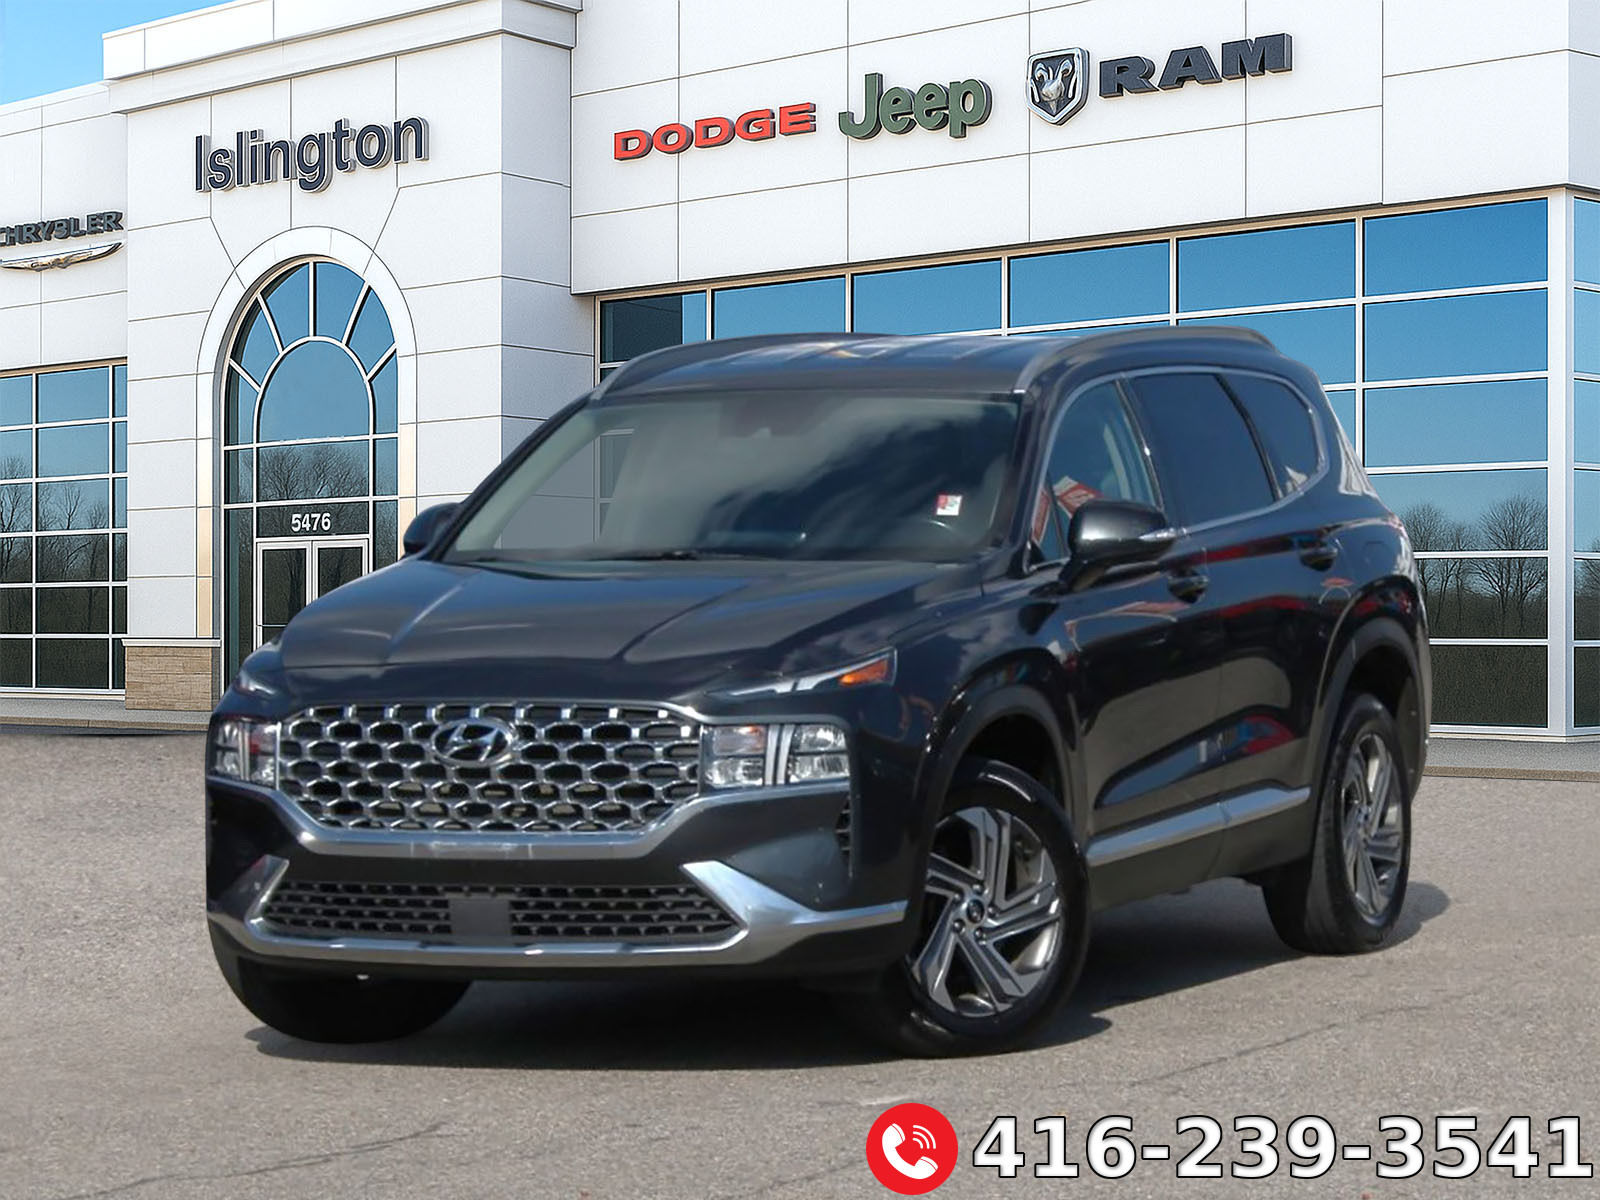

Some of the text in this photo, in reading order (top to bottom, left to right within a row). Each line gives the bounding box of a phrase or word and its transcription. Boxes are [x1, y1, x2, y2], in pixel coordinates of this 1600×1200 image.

[614, 33, 1293, 161] DODGE Jeep RAM
[195, 116, 430, 192] Islington
[291, 512, 331, 532] 5476
